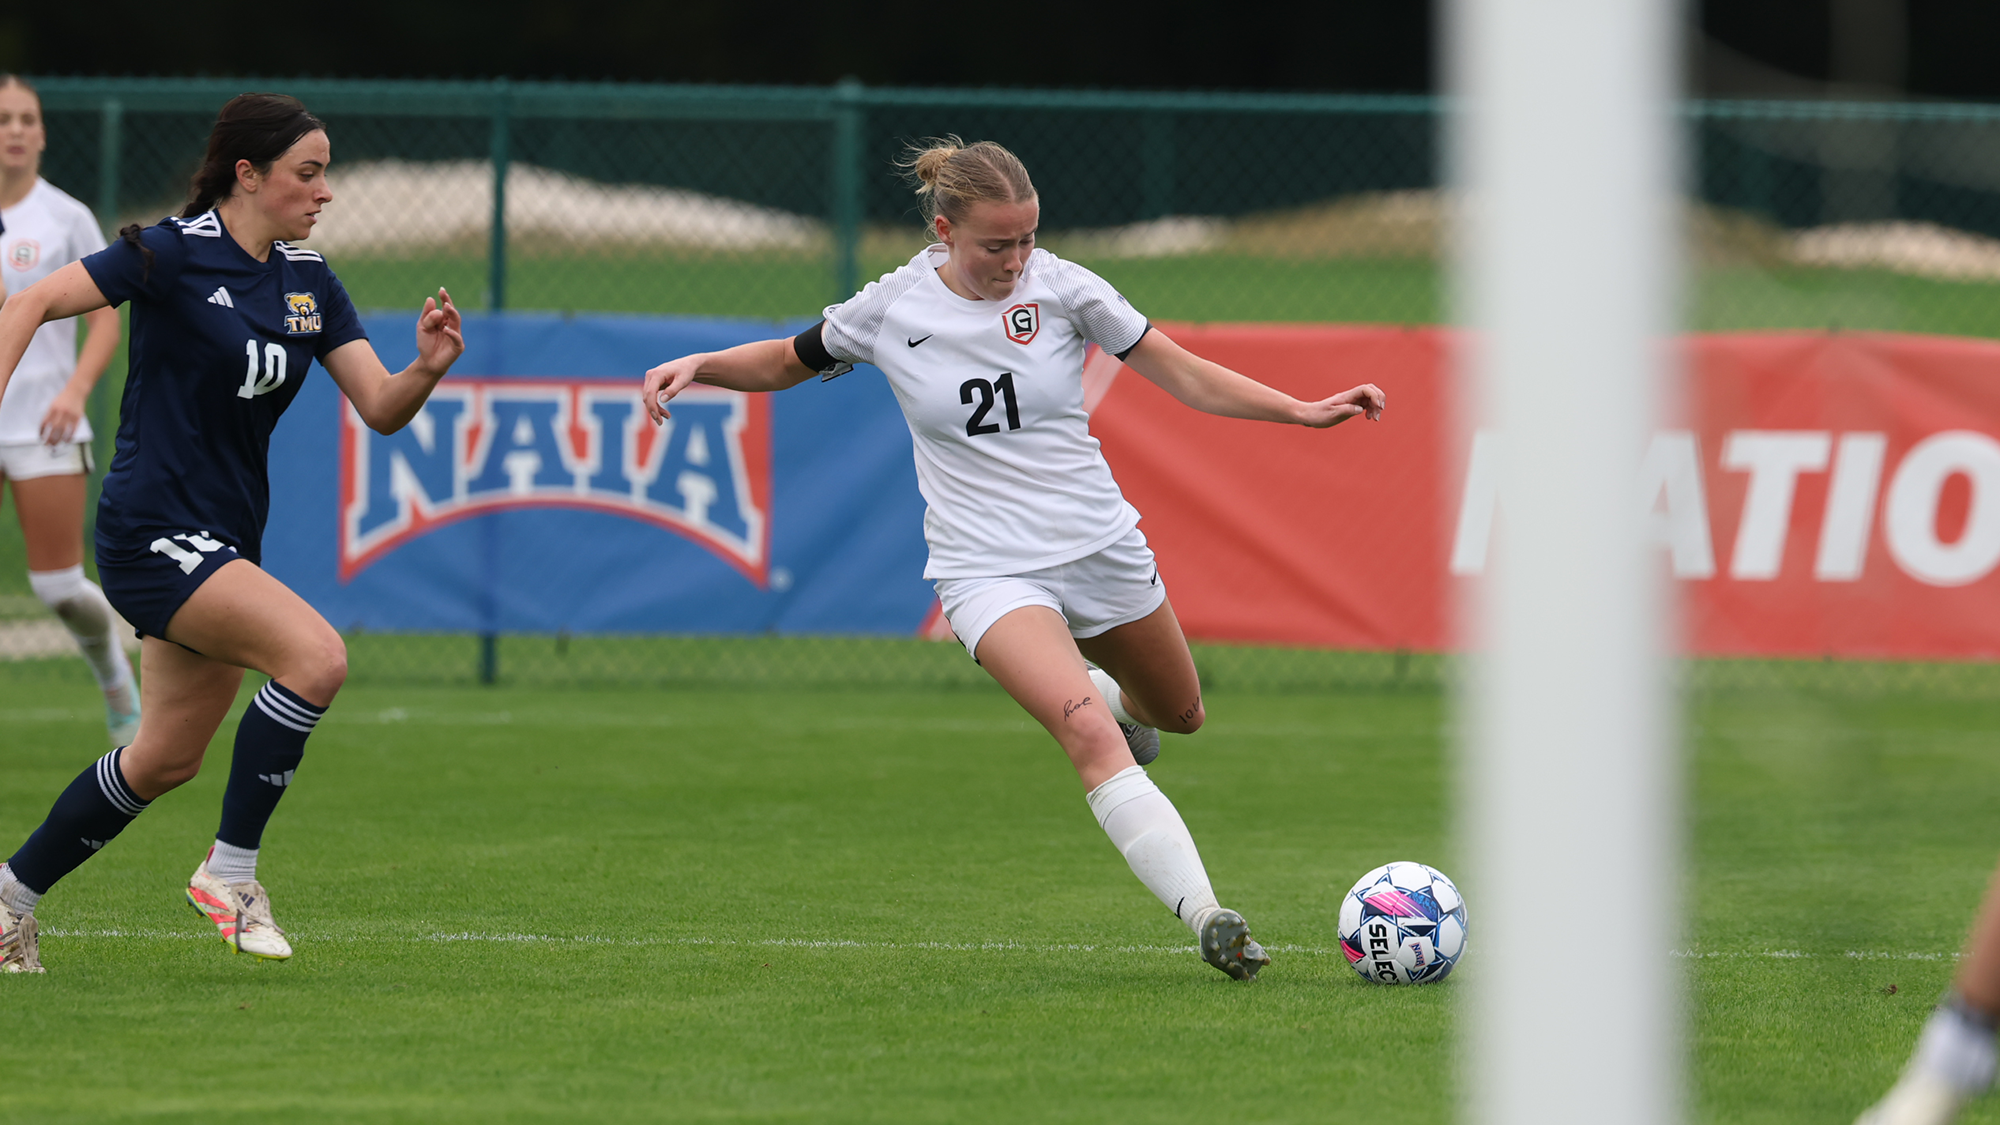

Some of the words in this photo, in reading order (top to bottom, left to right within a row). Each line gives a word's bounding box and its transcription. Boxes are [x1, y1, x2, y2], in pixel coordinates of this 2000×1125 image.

[286, 314, 322, 332] TMU
[1011, 308, 1033, 334] G
[237, 339, 287, 399] 10
[959, 372, 1021, 437] 21
[345, 383, 767, 570] NAIA
[1369, 924, 1400, 985] SELEC
[1409, 942, 1426, 969] NAIA
